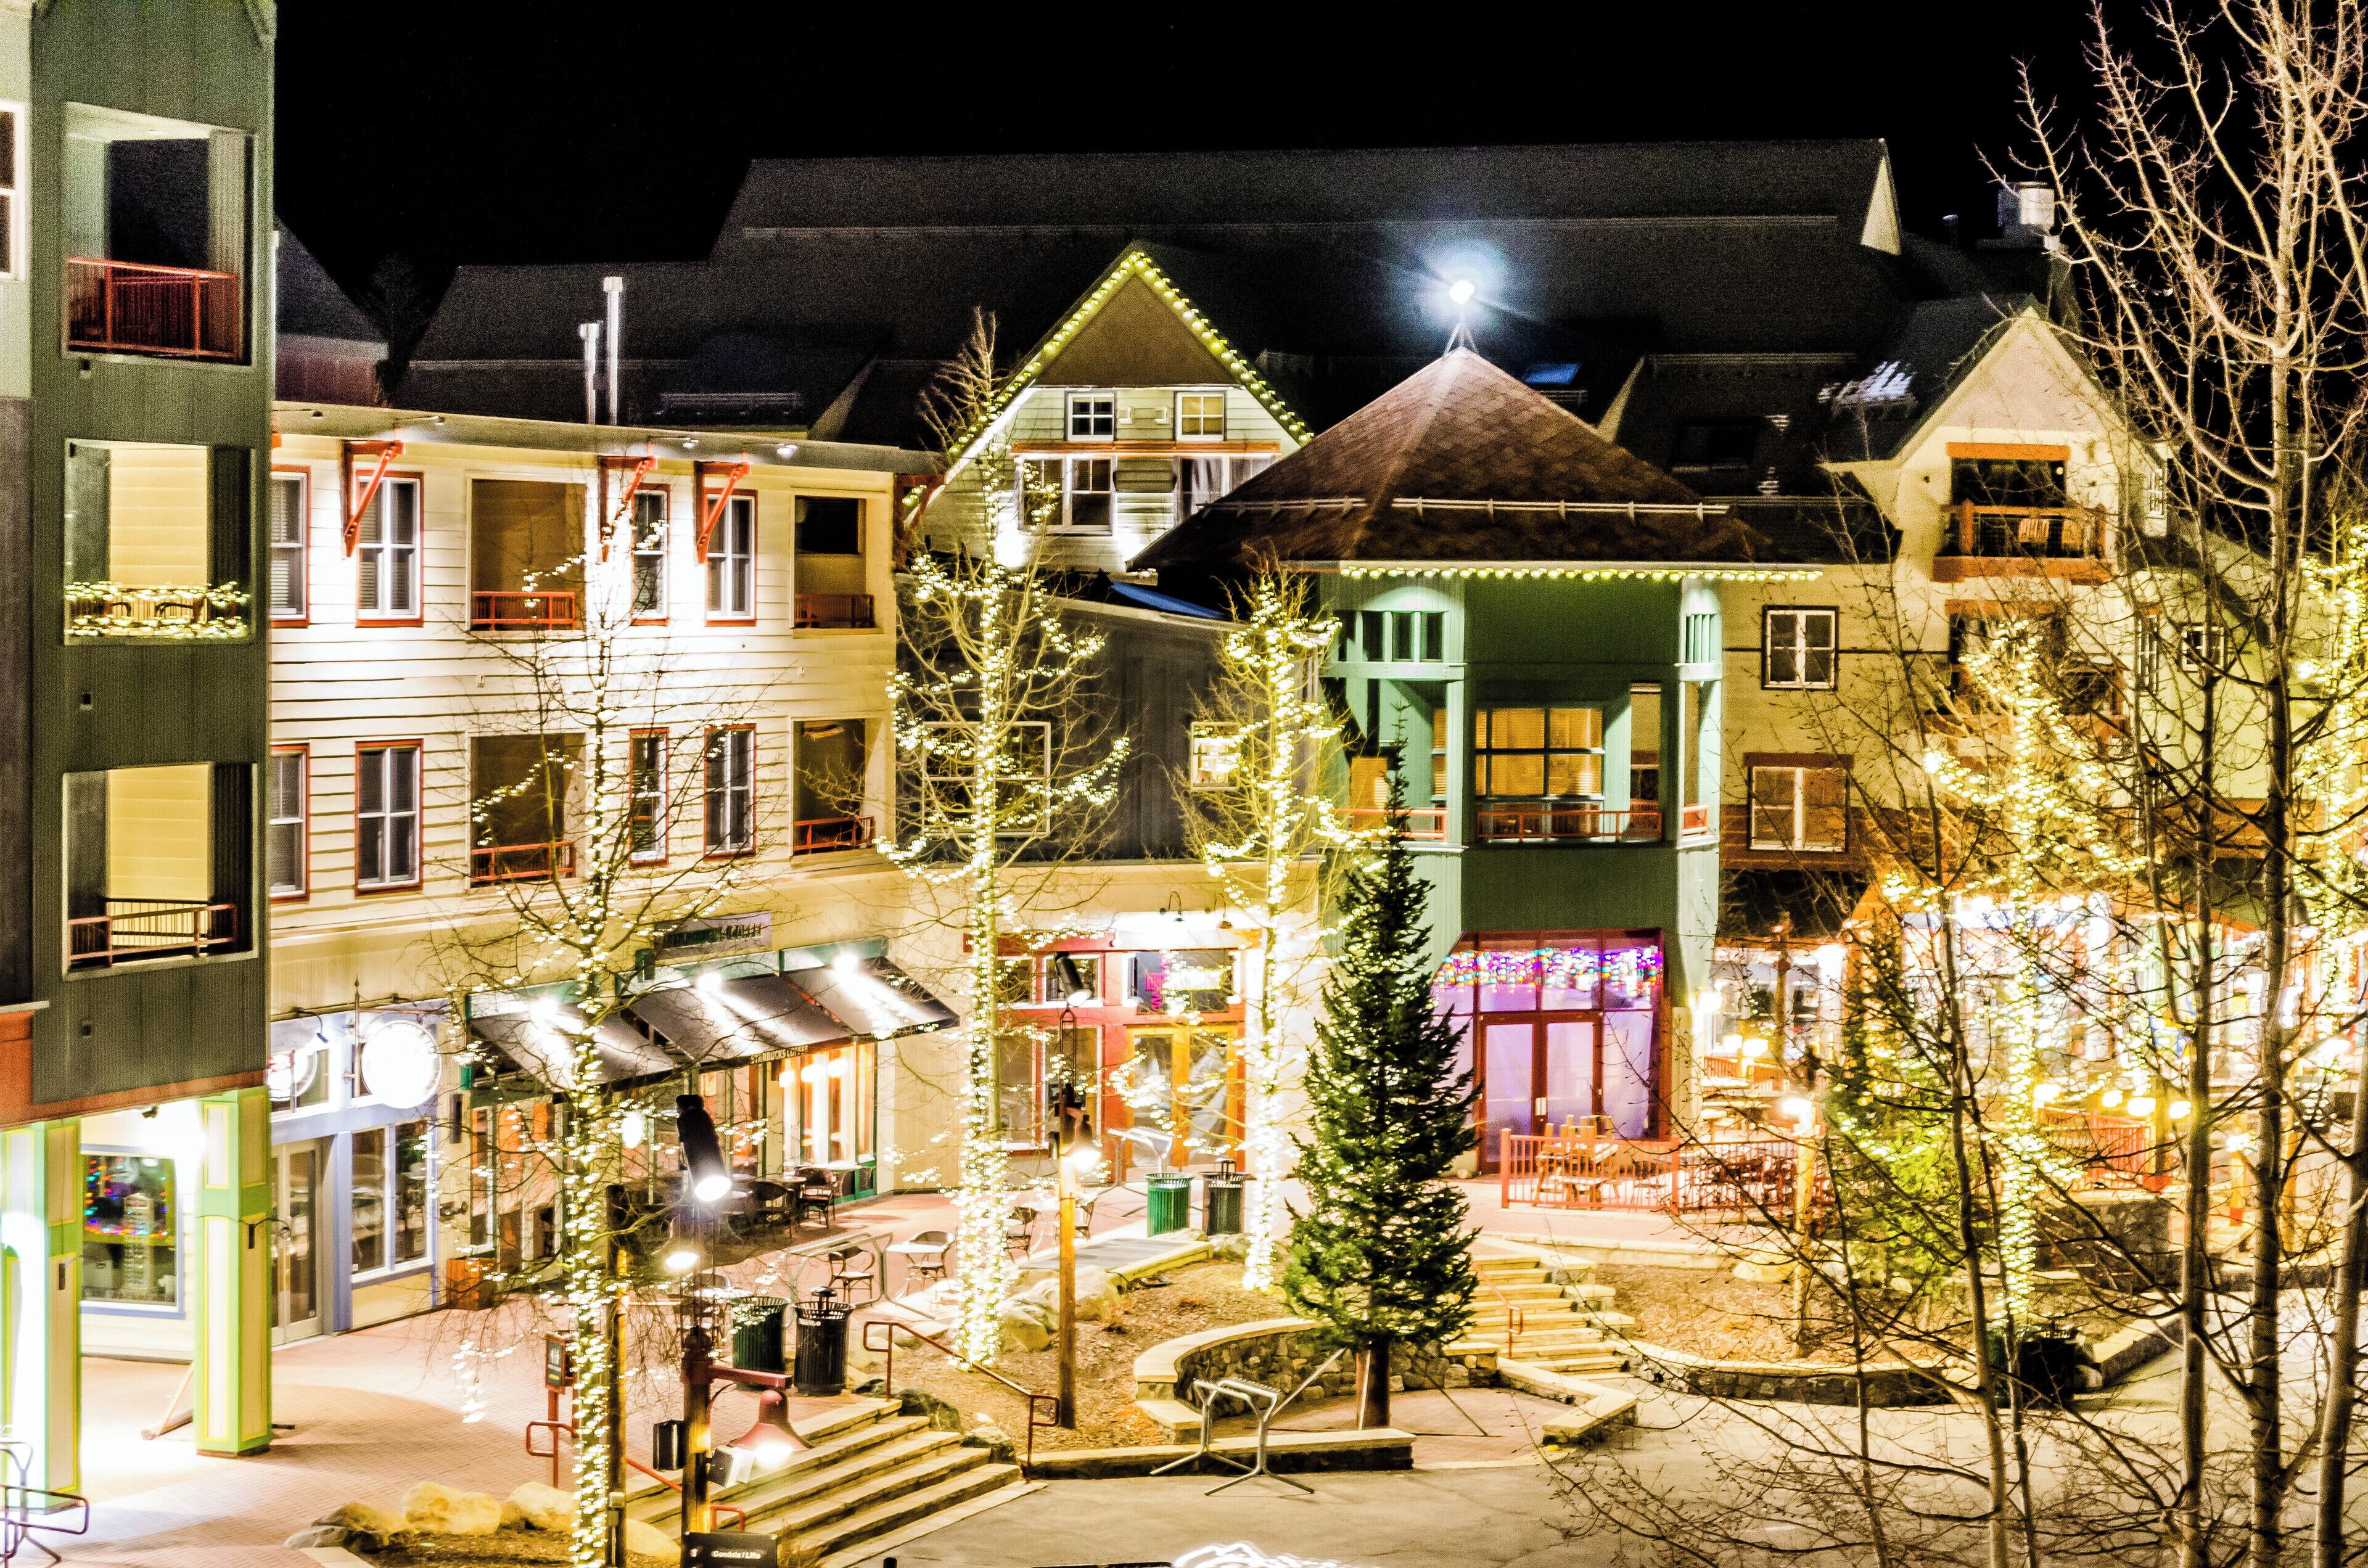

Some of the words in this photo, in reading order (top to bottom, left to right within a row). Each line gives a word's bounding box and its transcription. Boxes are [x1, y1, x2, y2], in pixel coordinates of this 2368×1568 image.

[750, 1049, 786, 1064] STARBUCKS
[711, 1550, 741, 1559] Gondola
[745, 1551, 761, 1559] Lifts
